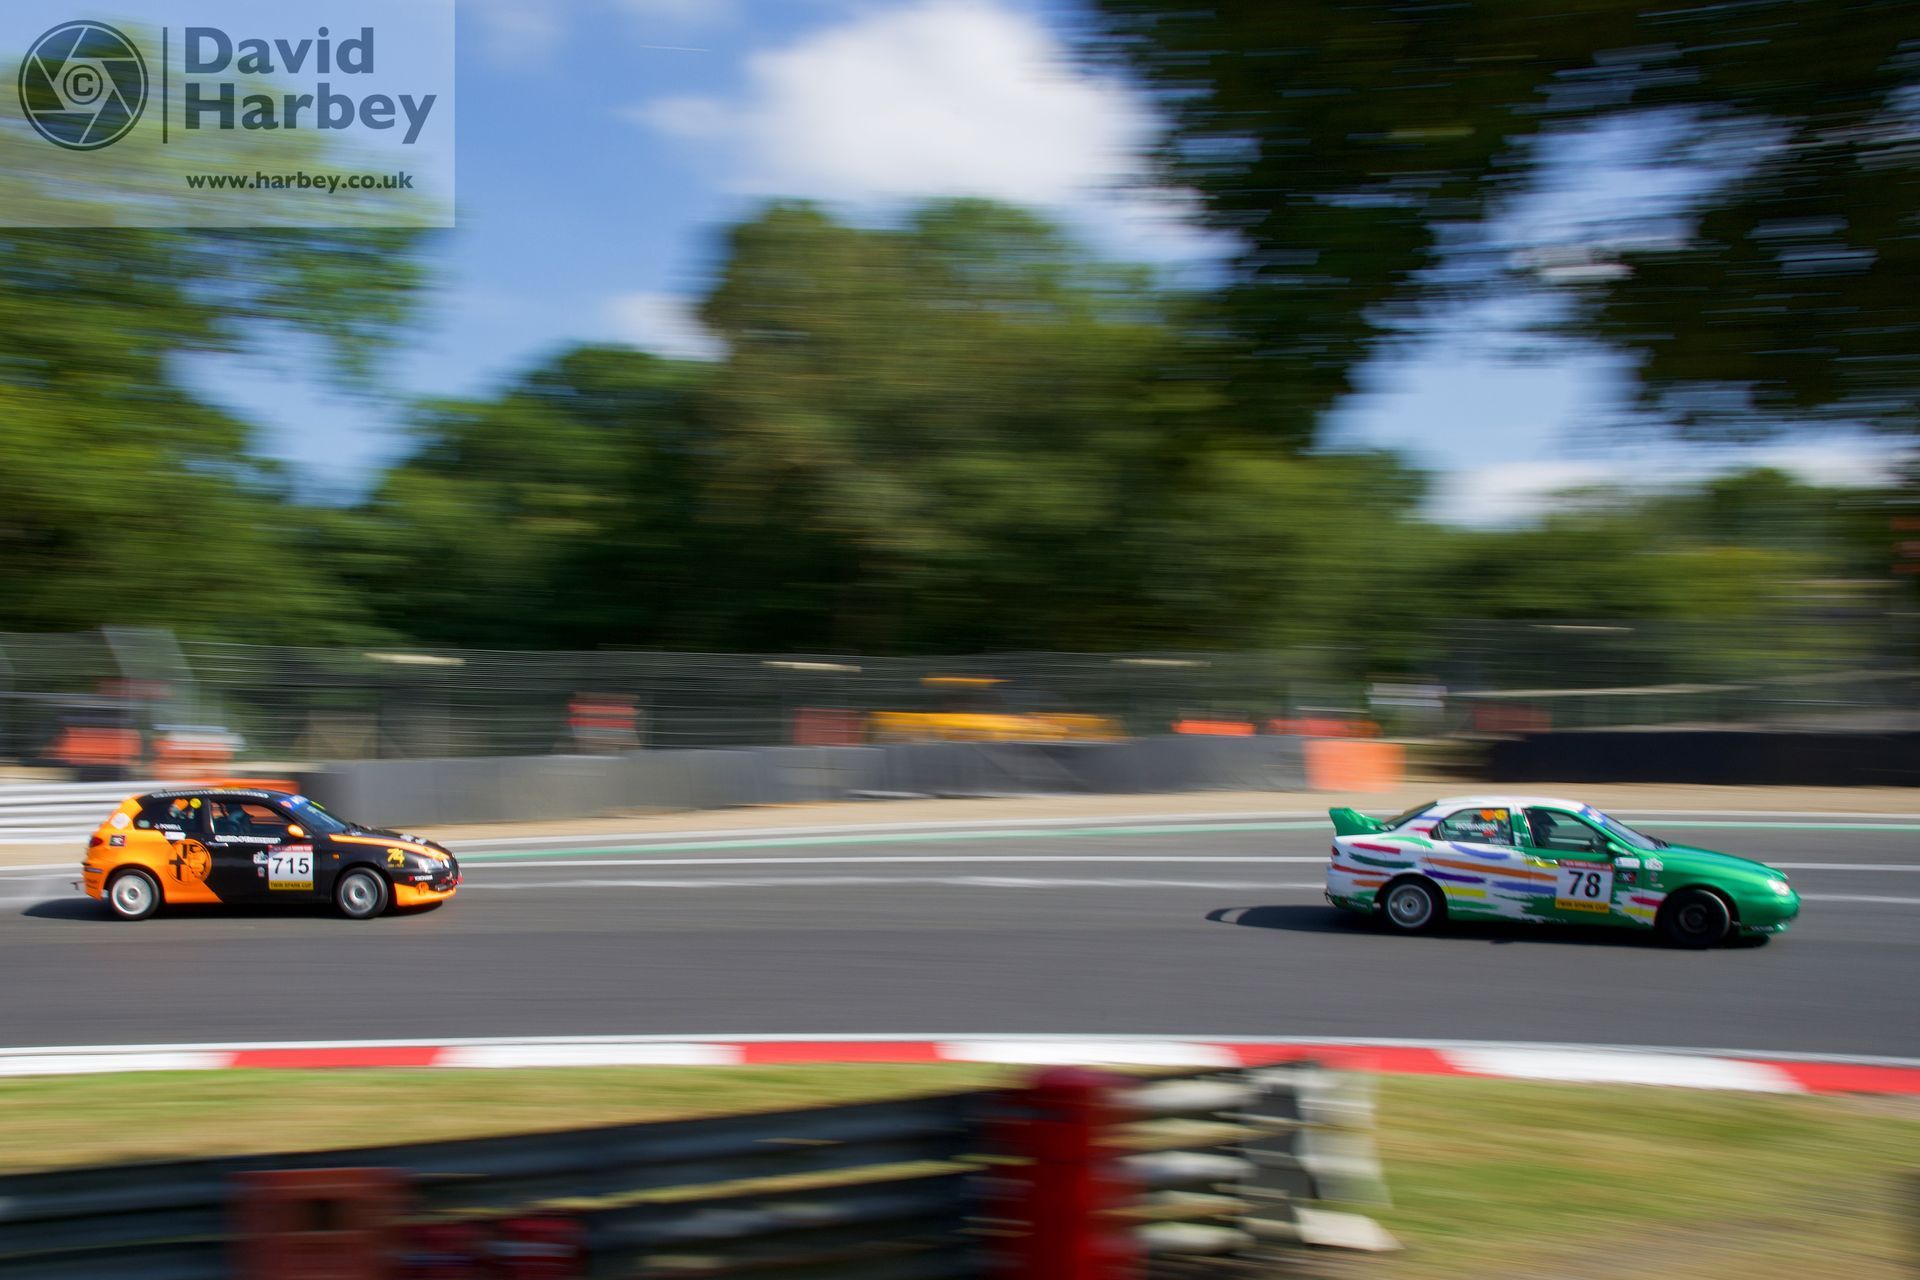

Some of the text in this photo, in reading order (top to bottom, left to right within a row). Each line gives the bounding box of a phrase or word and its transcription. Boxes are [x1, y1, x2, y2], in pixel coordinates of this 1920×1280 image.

[1455, 823, 1498, 831] ROBINSON
[272, 857, 309, 875] 715
[1568, 870, 1601, 898] 78
